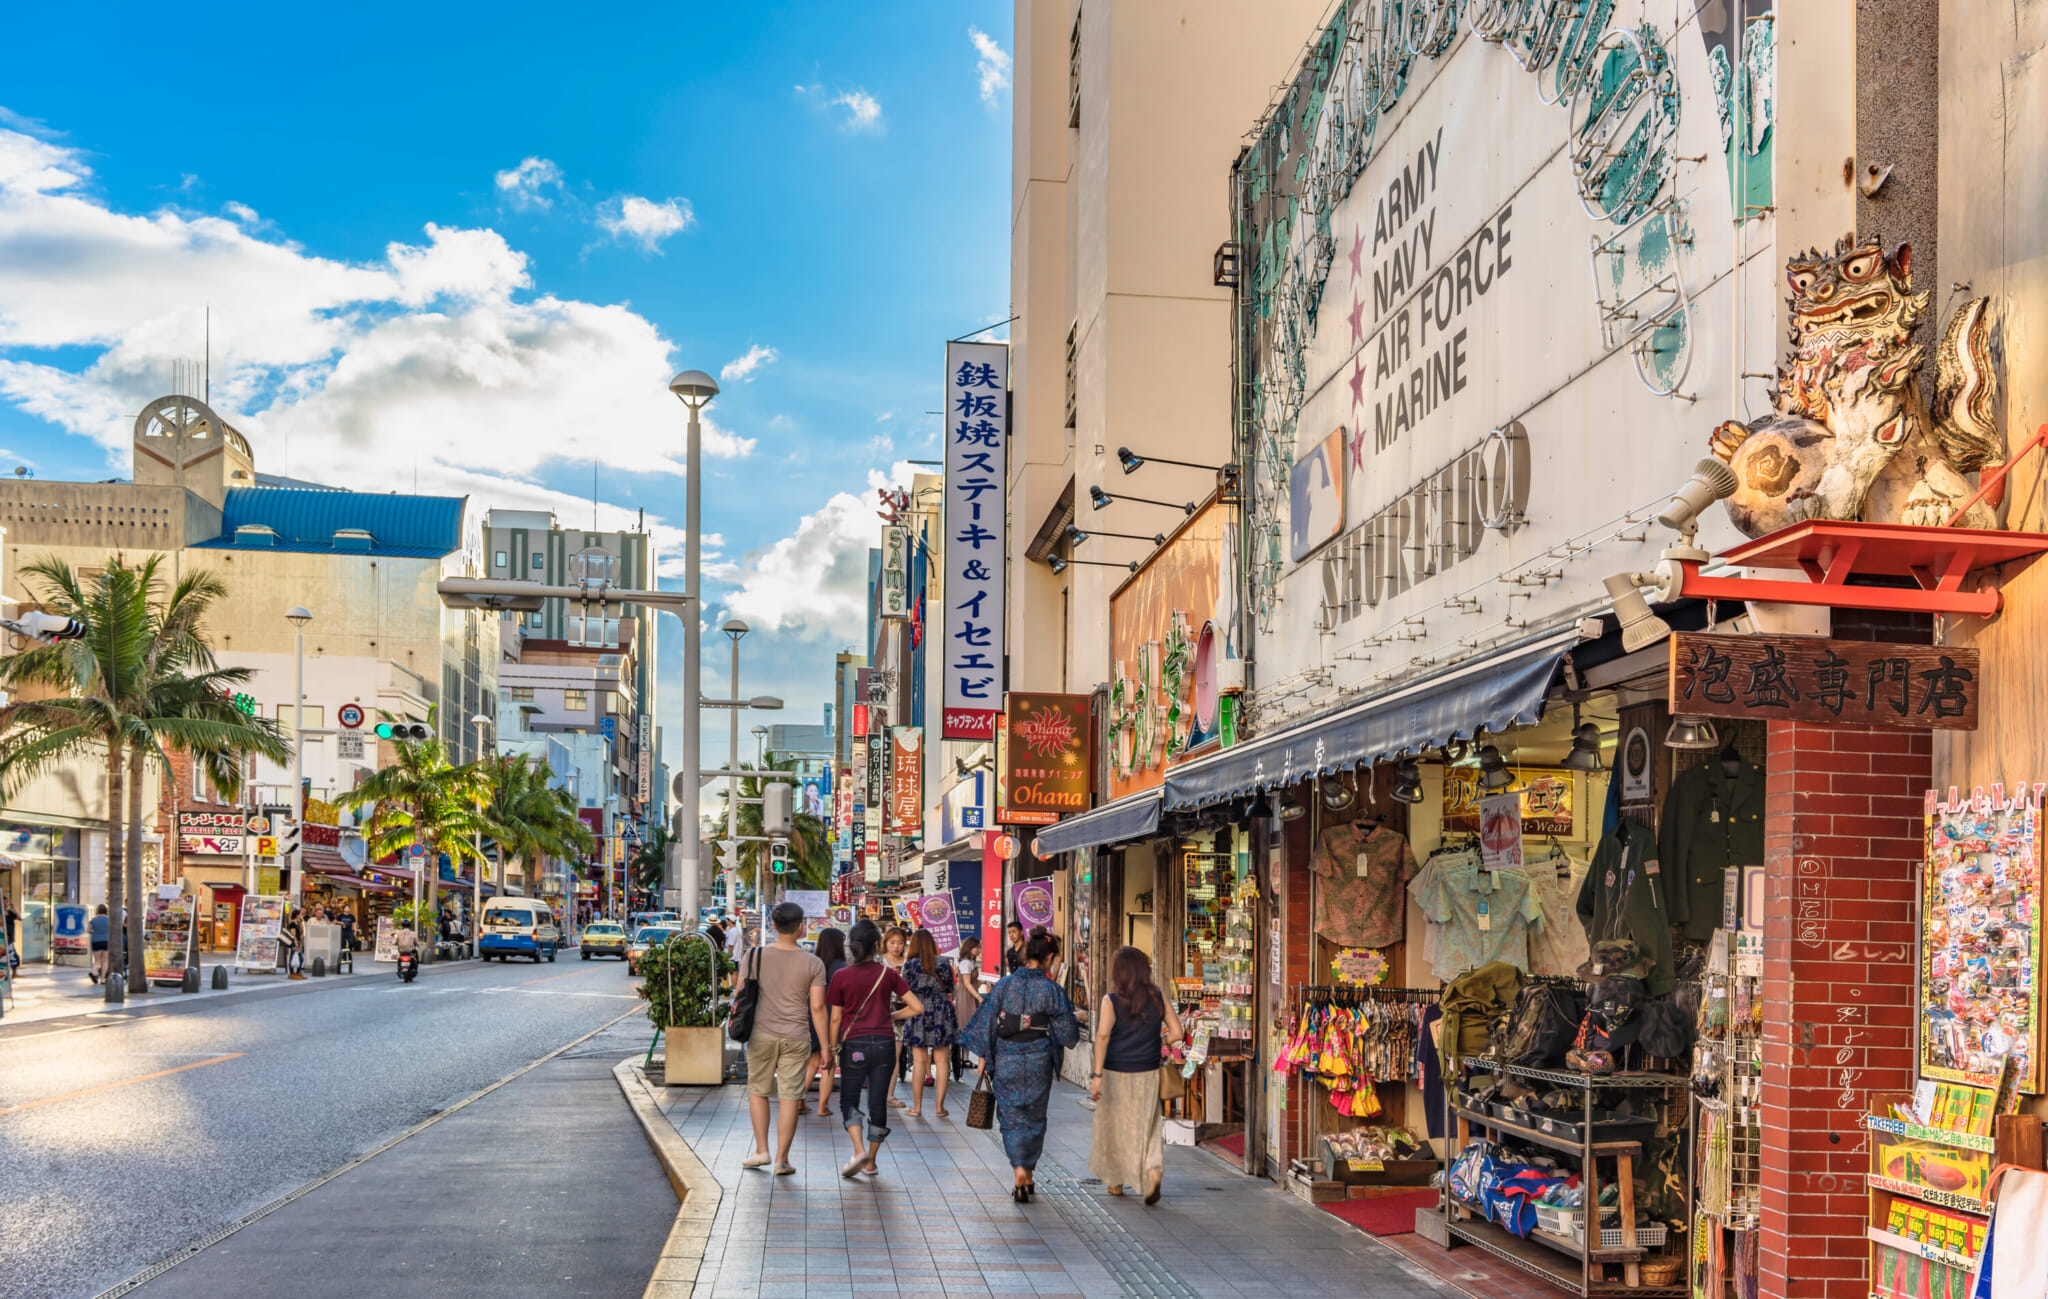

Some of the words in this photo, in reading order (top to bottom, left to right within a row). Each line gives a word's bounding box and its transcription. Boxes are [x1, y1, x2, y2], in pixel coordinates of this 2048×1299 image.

[1373, 125, 1443, 258] ARMY
[1374, 206, 1436, 323] NAVY
[1375, 309, 1410, 390] AIR
[1421, 204, 1512, 348] FORCE
[1375, 327, 1467, 455] MARINE
[1322, 421, 1531, 631] SHUREIDO
[1683, 645, 1973, 718] 泡盛専門店
[946, 713, 985, 729] キャプテンズ
[1027, 721, 1071, 736] Ohana
[897, 754, 919, 818] 琉球屋
[1014, 782, 1084, 806] Ohana
[1925, 782, 2046, 815] MAGNET
[220, 837, 239, 852] 2F
[258, 838, 273, 854] P
[1888, 1211, 1904, 1228] Map
[1908, 1216, 1923, 1234] Map
[1928, 1223, 1946, 1241] Map
[1947, 1229, 1964, 1248] Map
